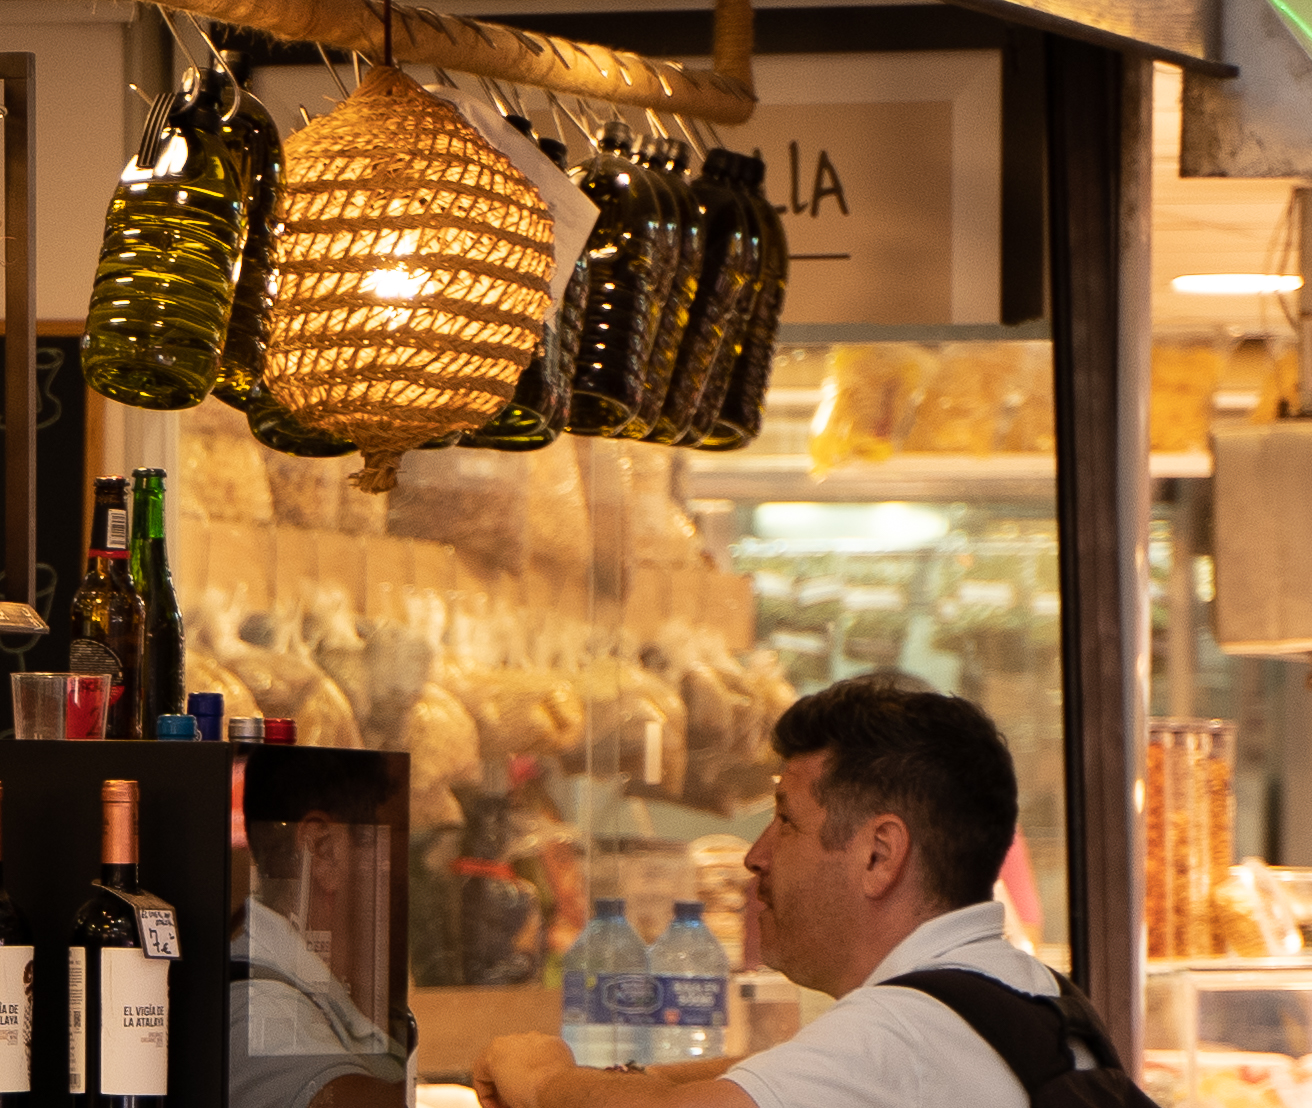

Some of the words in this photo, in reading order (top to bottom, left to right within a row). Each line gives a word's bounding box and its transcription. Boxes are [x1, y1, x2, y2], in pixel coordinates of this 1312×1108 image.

[778, 140, 850, 218] LA
[9, 1005, 19, 1014] DE
[124, 1006, 134, 1016] EL
[136, 1003, 155, 1016] VIGÍA
[124, 1017, 134, 1027] LA
